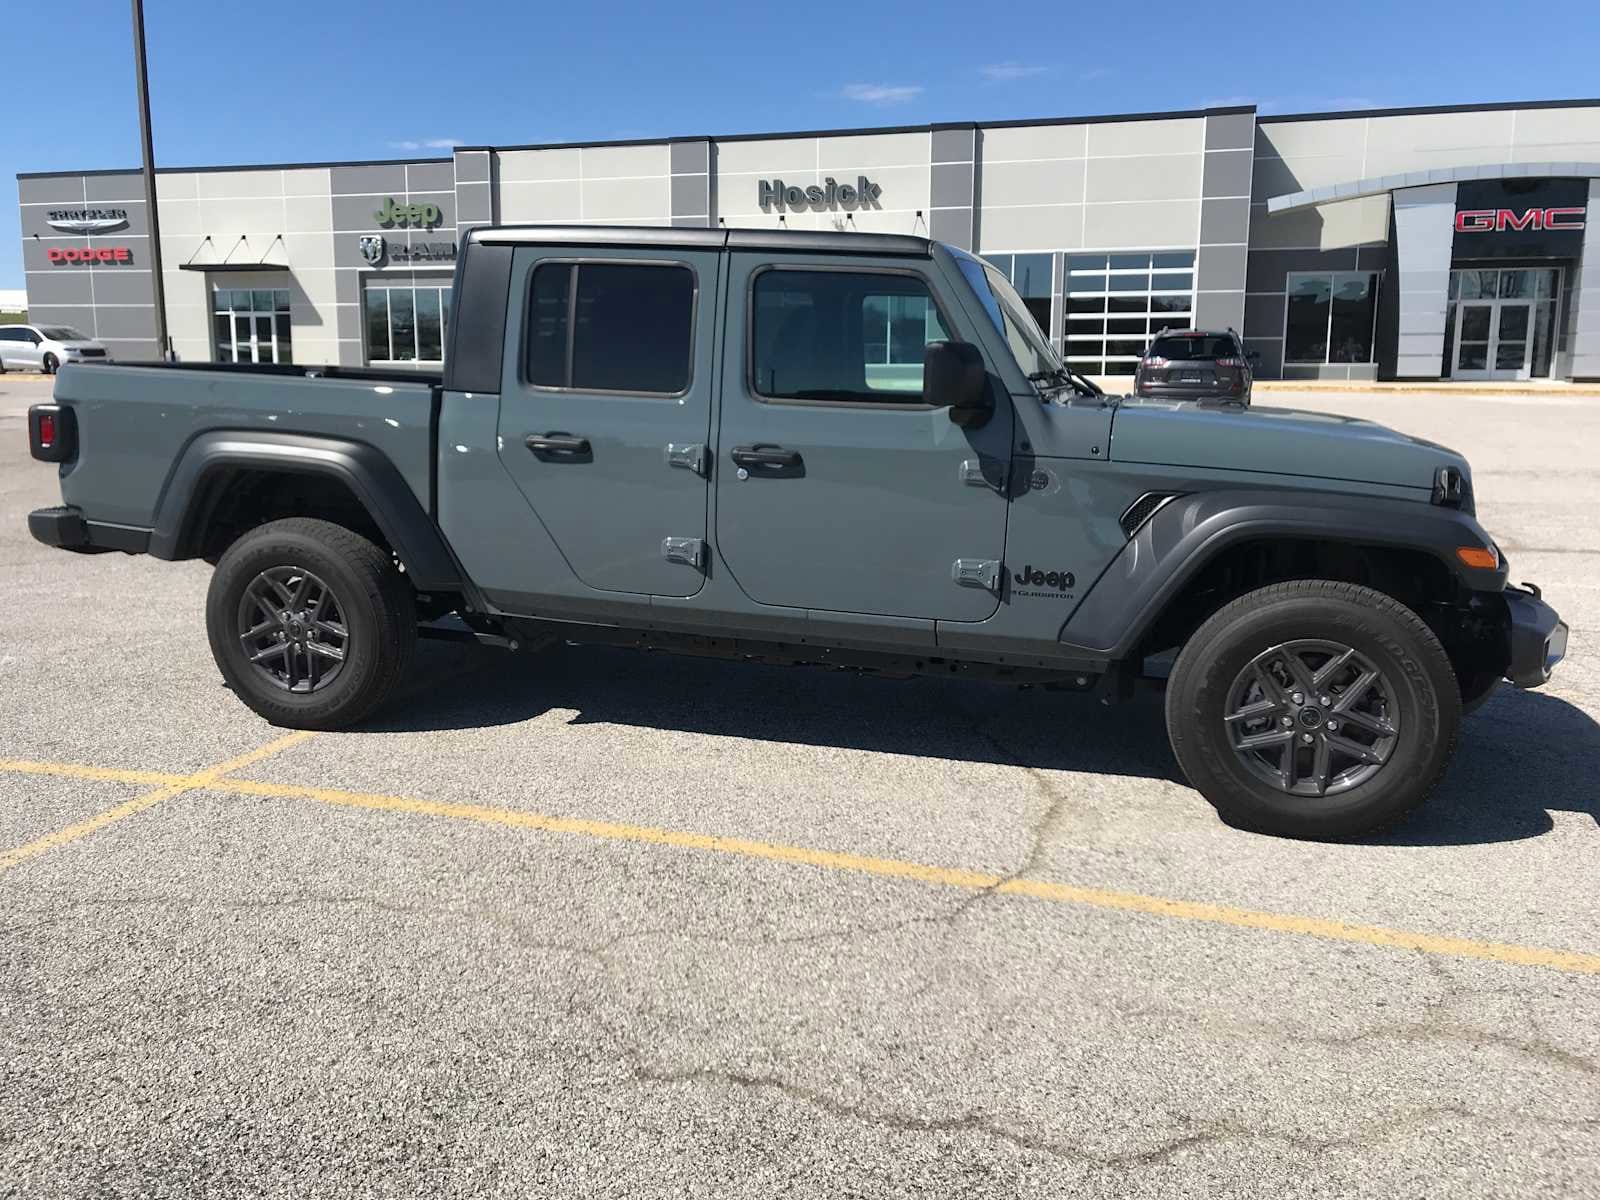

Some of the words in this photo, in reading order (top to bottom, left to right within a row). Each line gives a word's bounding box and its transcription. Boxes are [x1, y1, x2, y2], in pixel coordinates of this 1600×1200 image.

[759, 176, 882, 208] Hosick
[374, 196, 438, 224] Jeep
[1455, 207, 1586, 232] GMC
[47, 247, 129, 261] DODGE
[387, 243, 457, 258] RAM
[1014, 565, 1075, 591] Jeep
